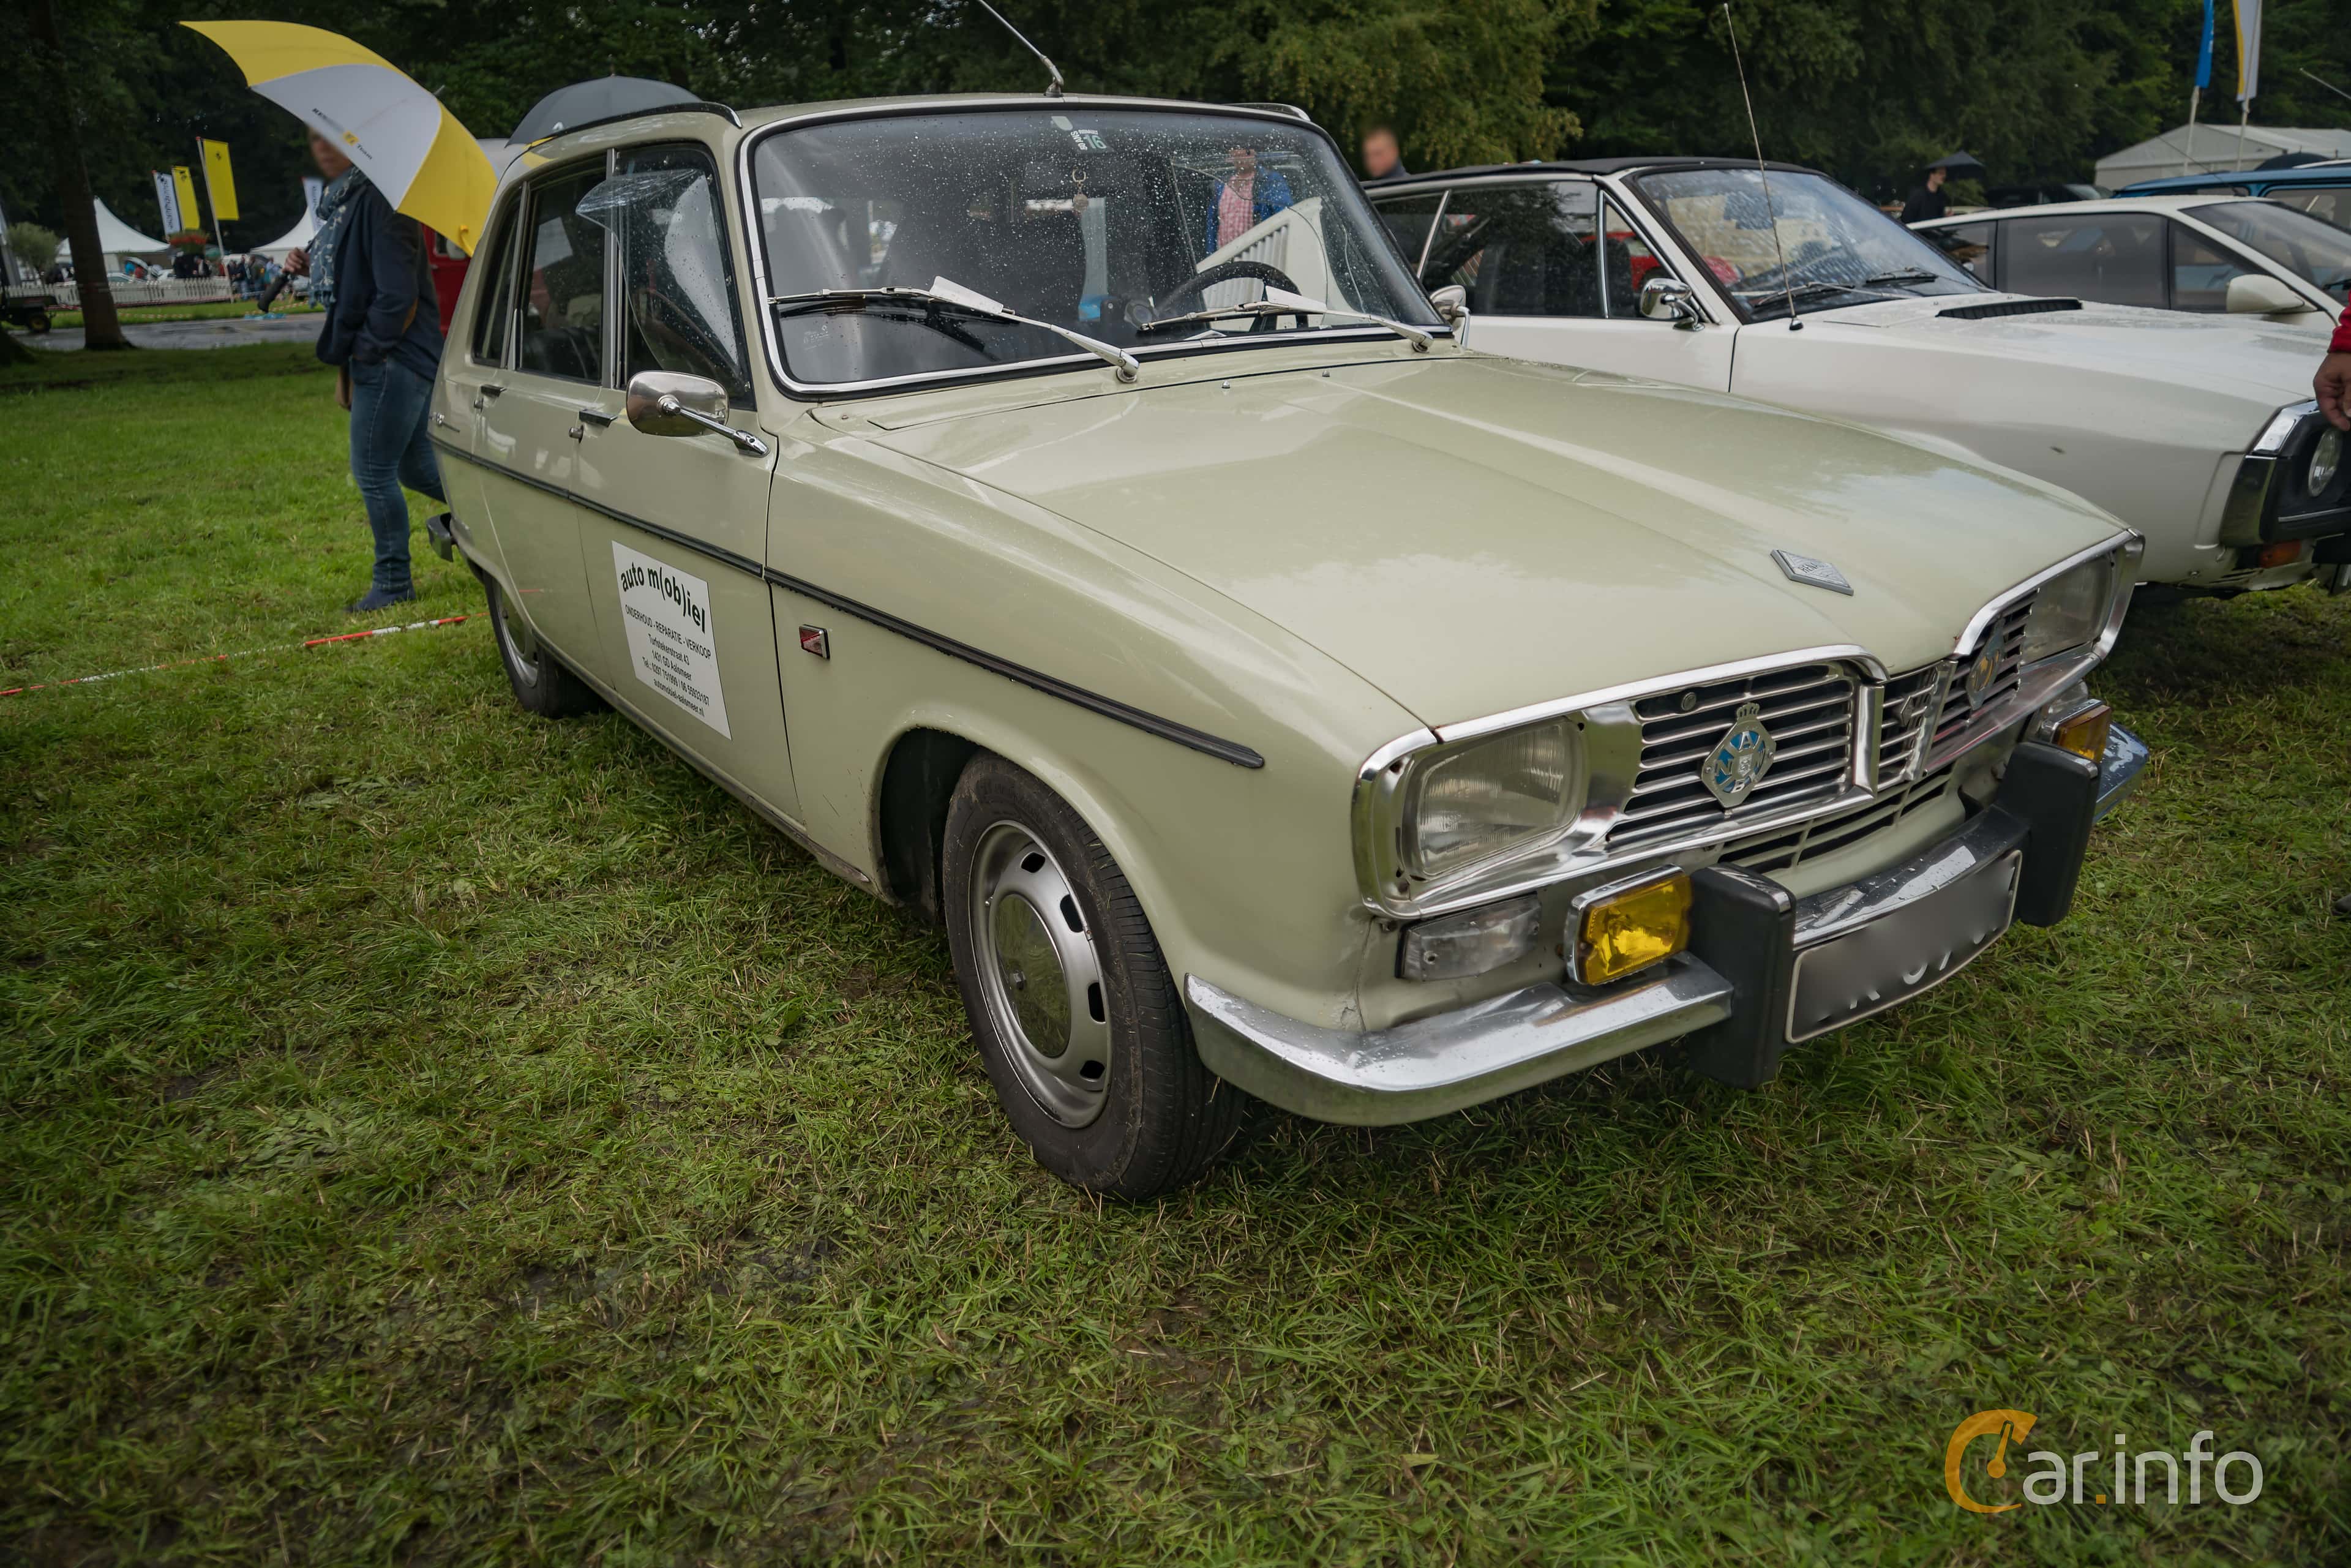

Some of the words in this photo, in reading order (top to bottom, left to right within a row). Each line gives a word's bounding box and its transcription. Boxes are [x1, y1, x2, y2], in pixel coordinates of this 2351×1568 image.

[1071, 131, 1084, 143] ANS
[1083, 135, 1107, 149] 16
[621, 561, 644, 592] auto
[648, 566, 705, 634] m(ob)iel
[624, 604, 653, 628] ONDERHOUD
[655, 620, 682, 645] REPARATIE
[684, 637, 711, 661] VERKOOP
[651, 649, 662, 664] 1431
[669, 660, 692, 682] Aalsmeer
[683, 653, 689, 666] 43
